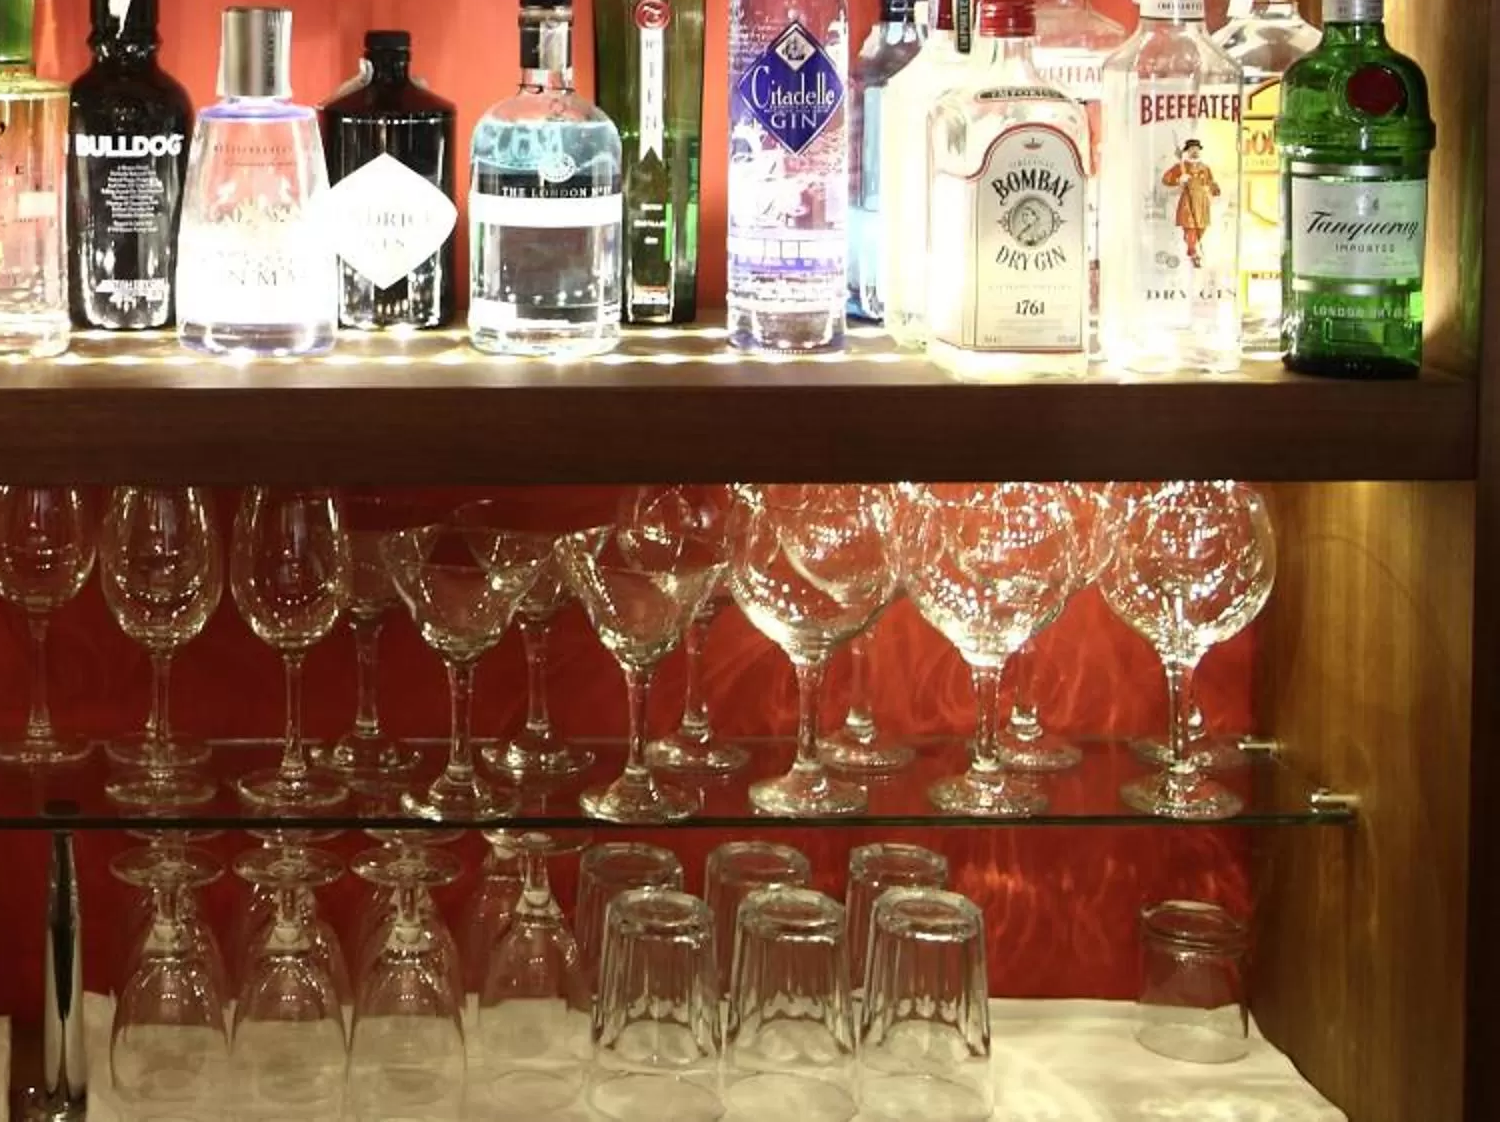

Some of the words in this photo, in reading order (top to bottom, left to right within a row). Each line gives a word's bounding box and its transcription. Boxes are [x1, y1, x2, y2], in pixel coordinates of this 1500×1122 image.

[751, 65, 835, 109] Citadelle
[770, 111, 817, 129] GIN
[1140, 92, 1242, 126] BEEFEATER
[75, 133, 182, 157] BULLDOG
[501, 186, 526, 198] THE
[531, 187, 587, 198] LONDON
[991, 168, 1075, 206] BOMBAY
[1306, 210, 1420, 242] Tanqueray
[995, 245, 1030, 271] DRY
[1033, 245, 1067, 271] GIN
[1334, 243, 1396, 254] IMPORTED
[1015, 298, 1045, 316] 1761
